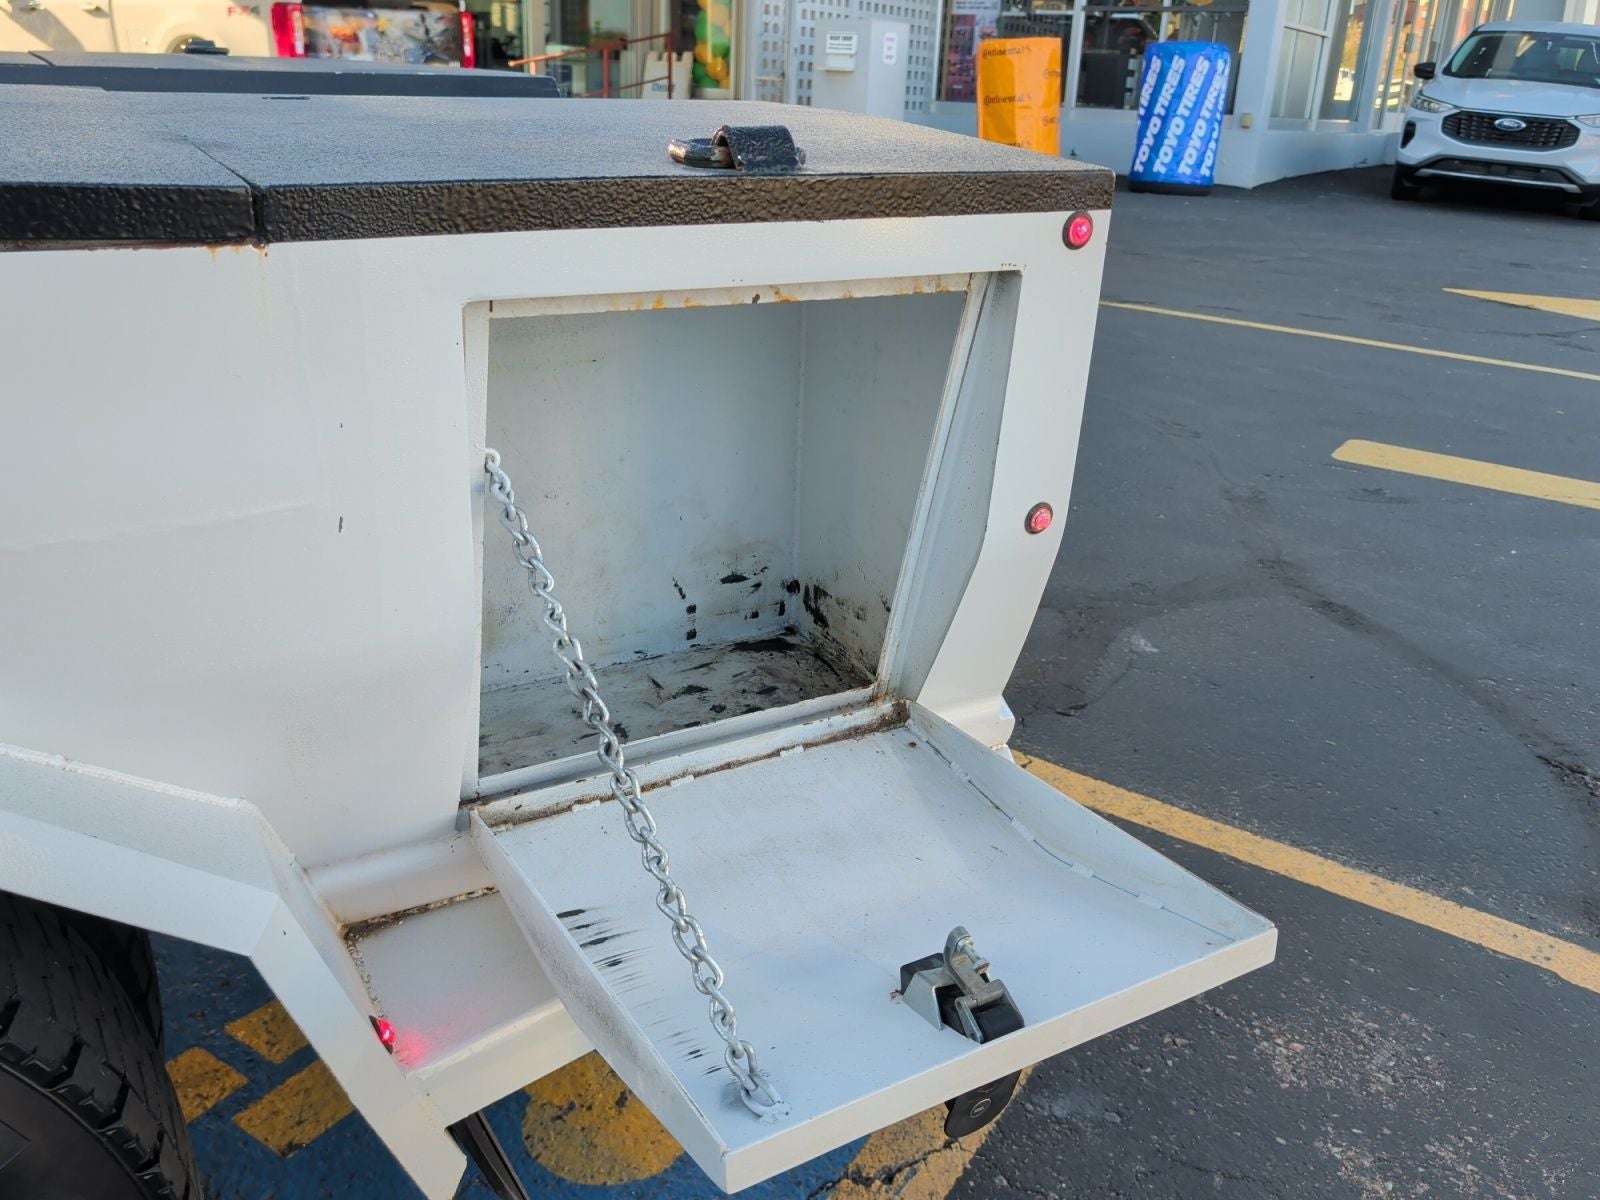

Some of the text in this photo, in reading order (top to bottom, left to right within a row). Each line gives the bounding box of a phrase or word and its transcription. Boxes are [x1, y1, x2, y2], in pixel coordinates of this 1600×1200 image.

[1134, 55, 1185, 173] TOYO TIRES
[1152, 55, 1210, 174] TOYO TIRES
[1178, 118, 1207, 176] TOYO
